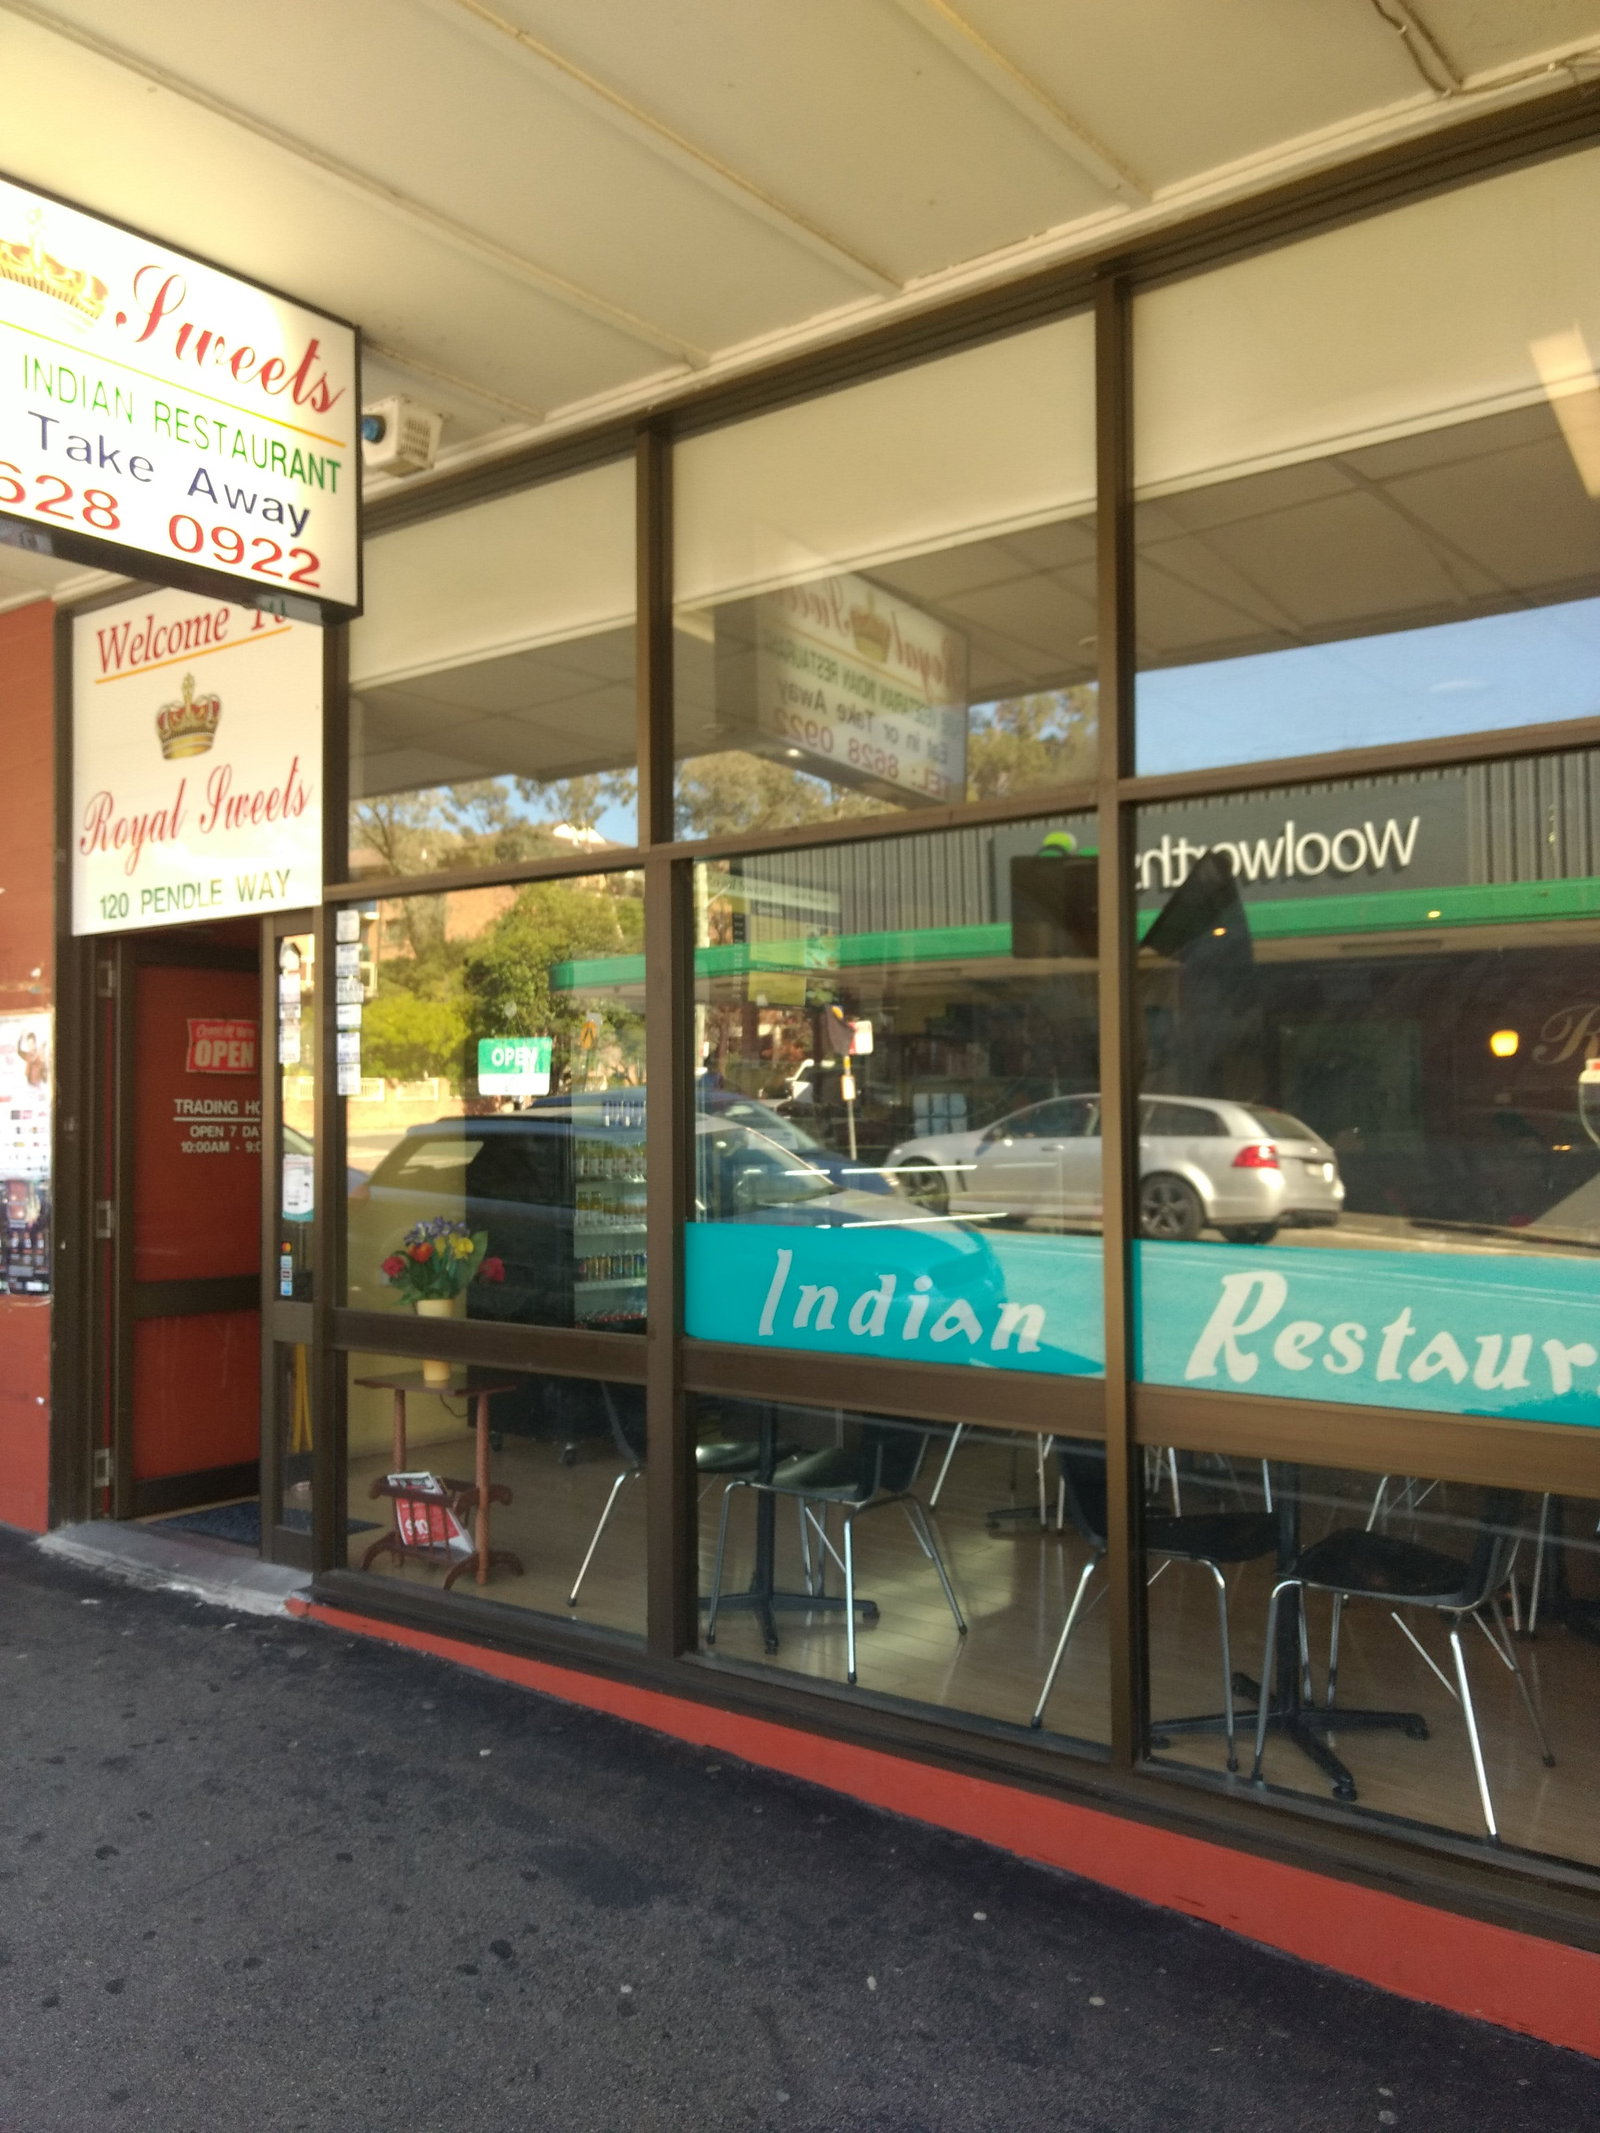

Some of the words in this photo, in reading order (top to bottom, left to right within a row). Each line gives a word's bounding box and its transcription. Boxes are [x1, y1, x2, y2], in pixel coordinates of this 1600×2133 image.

[115, 264, 346, 415] Sweets
[22, 354, 134, 424] INDIAN
[154, 400, 342, 494] RESTAURANT
[28, 410, 155, 483] Take
[187, 467, 312, 538] Away
[167, 513, 321, 588] 0922
[96, 606, 230, 674] Welcome
[80, 777, 188, 877] Royal
[200, 755, 314, 835] Sweets
[99, 892, 130, 920] 120
[140, 878, 224, 915] PENDLE
[236, 868, 292, 902] WAY
[194, 1039, 255, 1068] OPEN
[490, 1046, 539, 1068] OPEN
[174, 1099, 239, 1115] TRADING
[189, 1125, 225, 1138] OPEN
[229, 1125, 238, 1138] 7
[181, 1141, 230, 1153] 10:00AM
[757, 1248, 1047, 1353] Indian
[1184, 1270, 1600, 1395] Restaur
